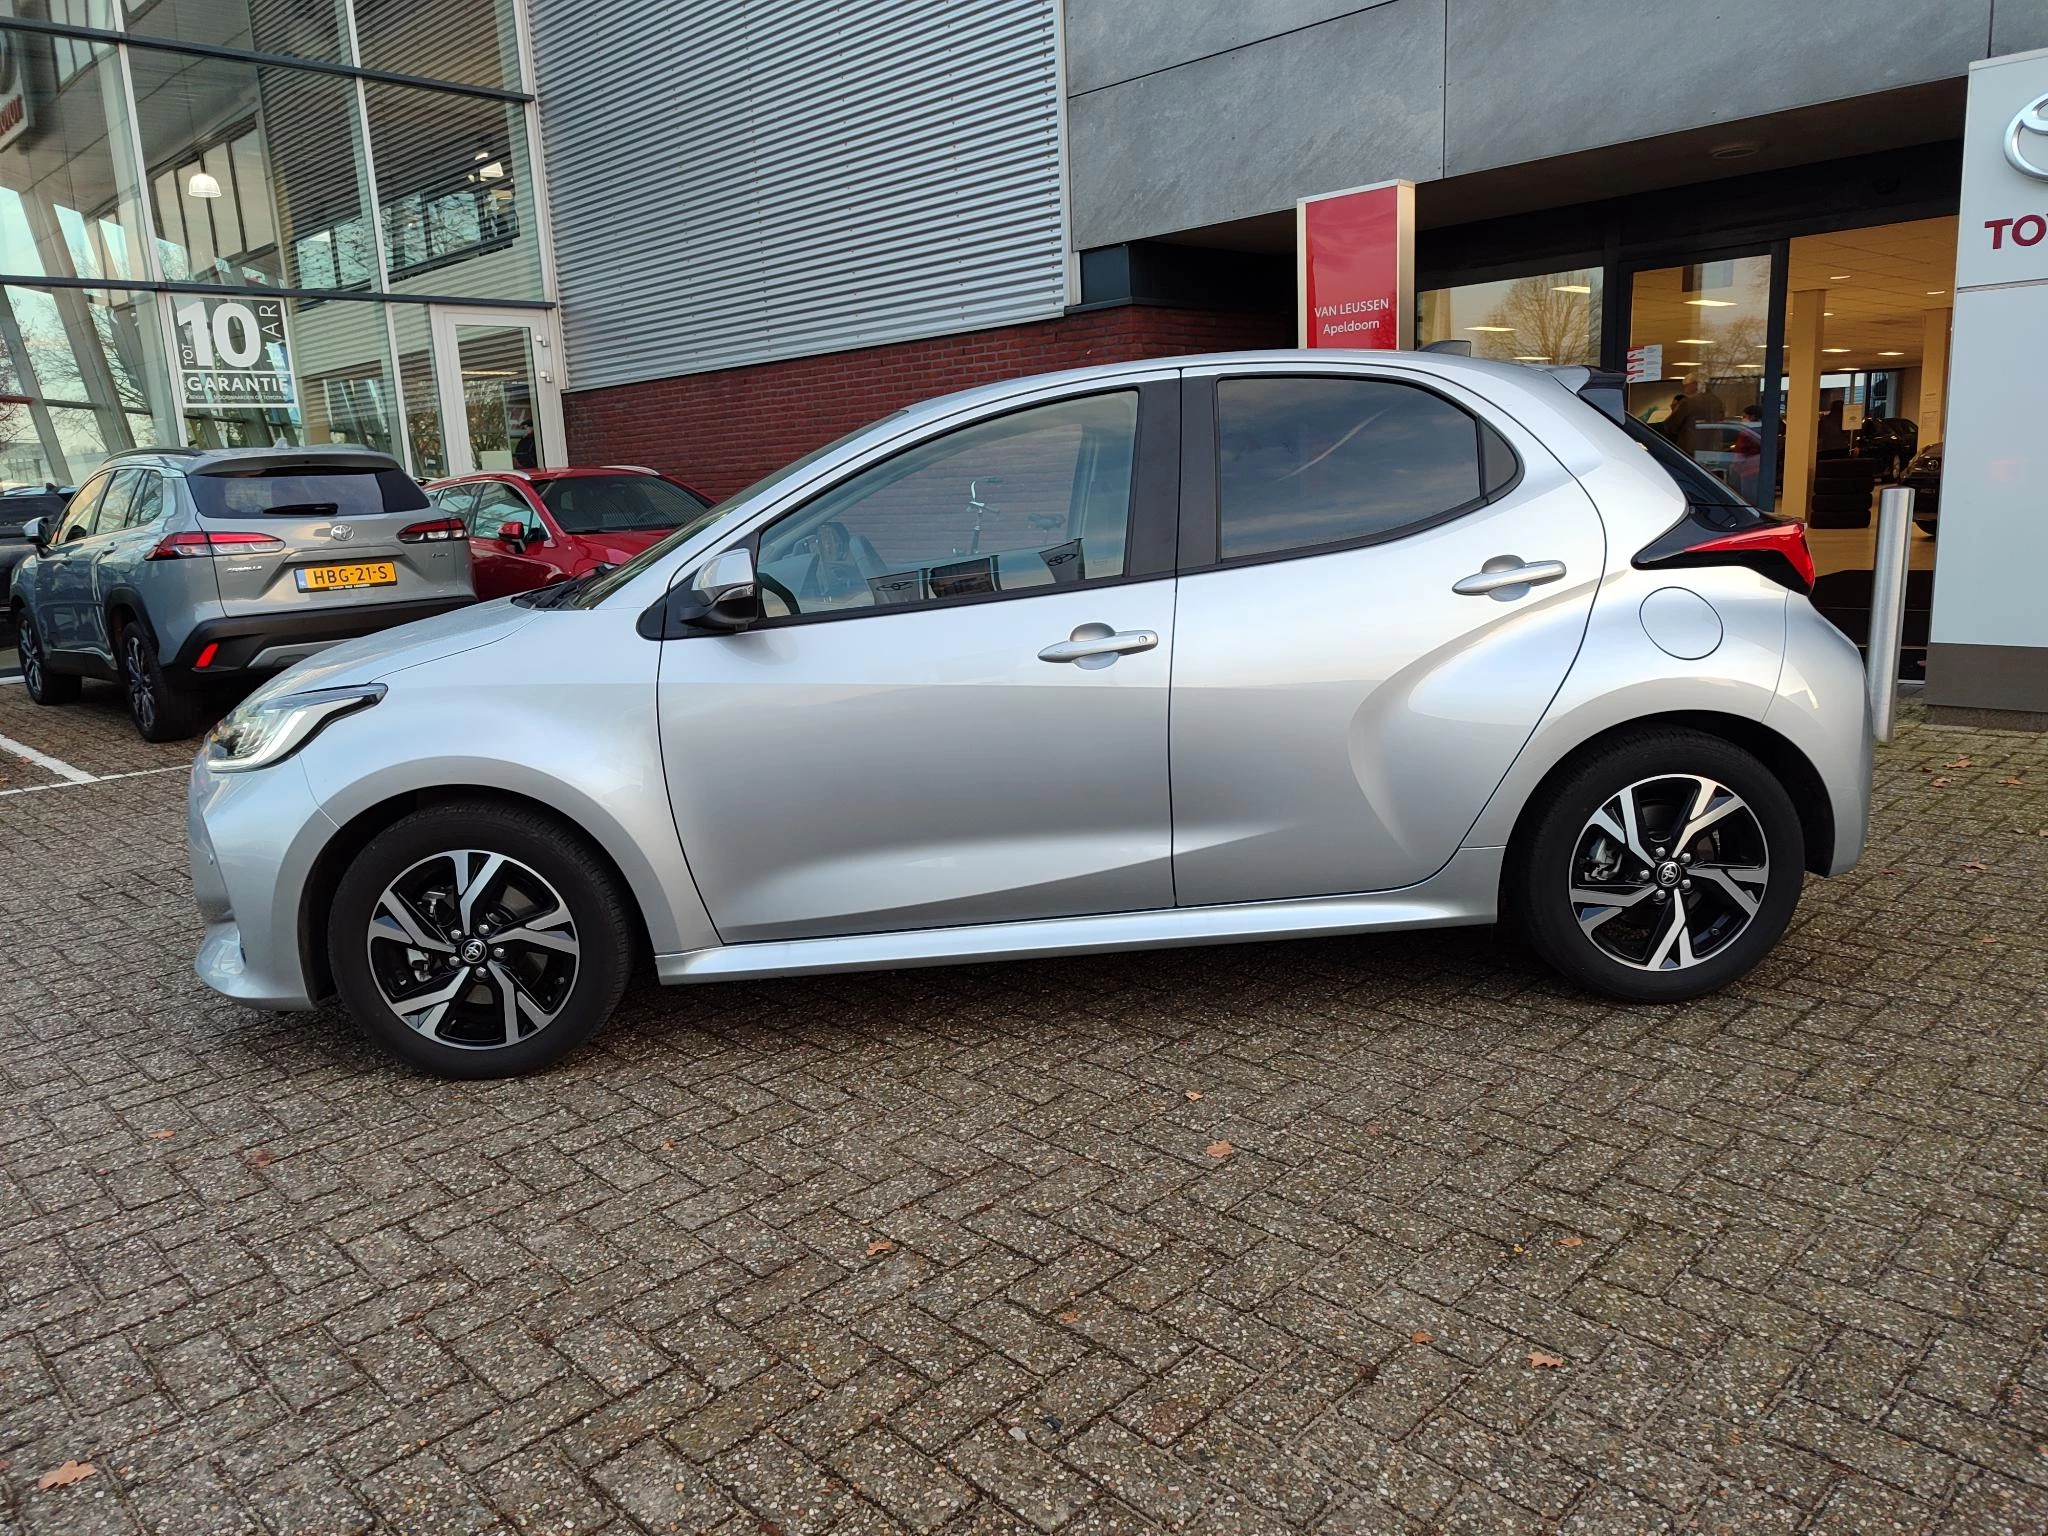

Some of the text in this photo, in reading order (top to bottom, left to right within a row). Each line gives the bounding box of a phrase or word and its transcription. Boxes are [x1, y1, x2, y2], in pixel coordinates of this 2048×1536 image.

[1984, 213, 2048, 250] TO
[1314, 298, 1389, 318] VAN LEUSSEN
[177, 301, 285, 368] TOT 10 AAR
[1323, 320, 1380, 336] Apeldoorn
[187, 376, 289, 392] GARANTIE
[313, 566, 388, 585] HBG-21-S
